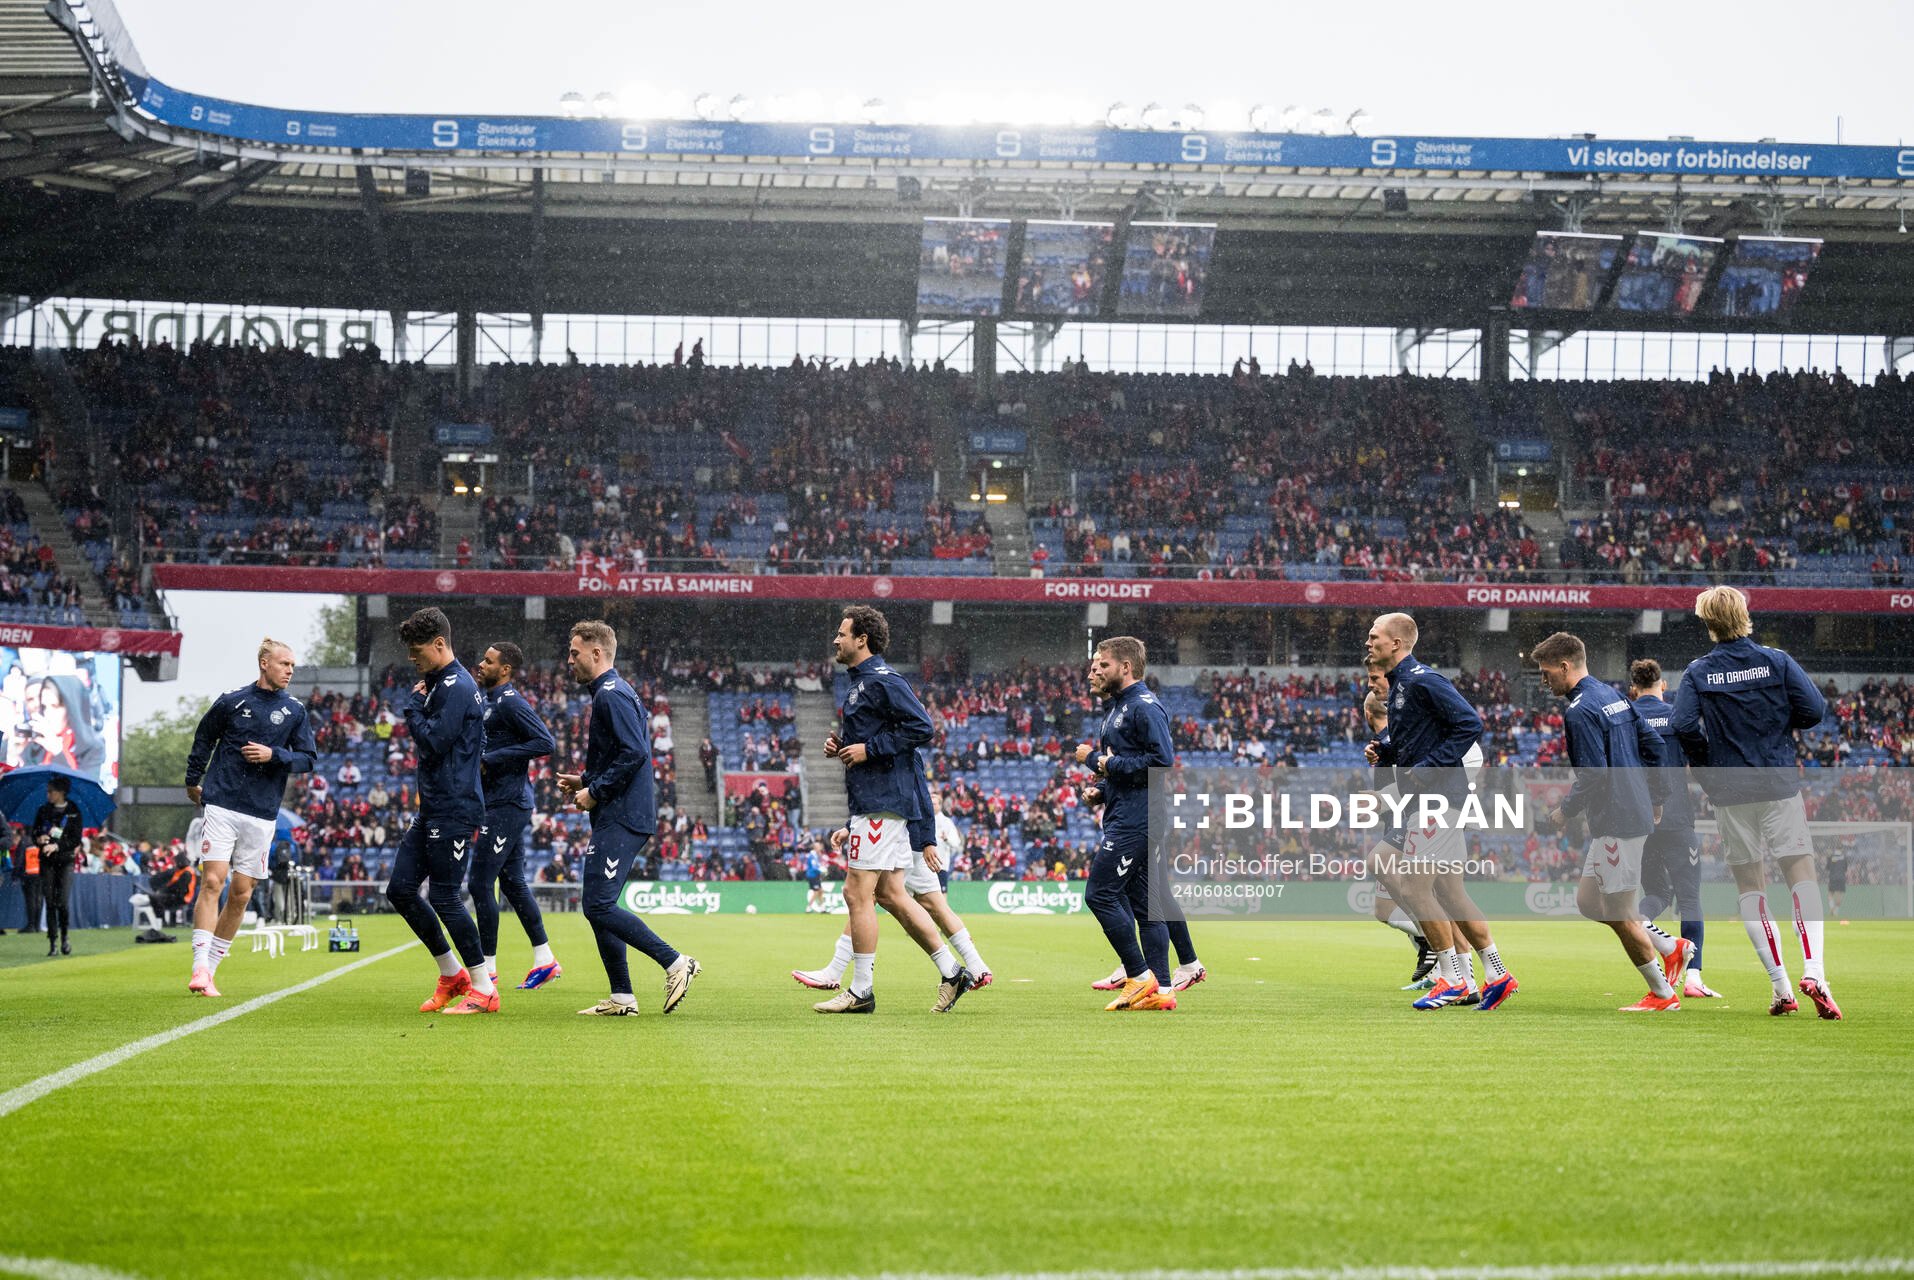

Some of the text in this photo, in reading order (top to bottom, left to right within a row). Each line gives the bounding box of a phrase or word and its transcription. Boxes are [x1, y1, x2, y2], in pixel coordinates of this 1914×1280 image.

[1567, 147, 1812, 170] Vi skaber forbindelser
[617, 578, 638, 592] AT
[642, 576, 674, 592] STÅ
[677, 578, 753, 594] SAMMEN
[1045, 582, 1153, 598] FOR HOLDET
[1467, 588, 1591, 603] FOR DANMARK
[1890, 594, 1914, 608] FO
[0, 628, 34, 644] REN
[1707, 666, 1770, 684] FOR DANMARK
[850, 834, 861, 860] 8
[625, 882, 720, 914] Carlsberg
[988, 882, 1083, 914] Carlsberg
[1525, 882, 1578, 914] Carls
